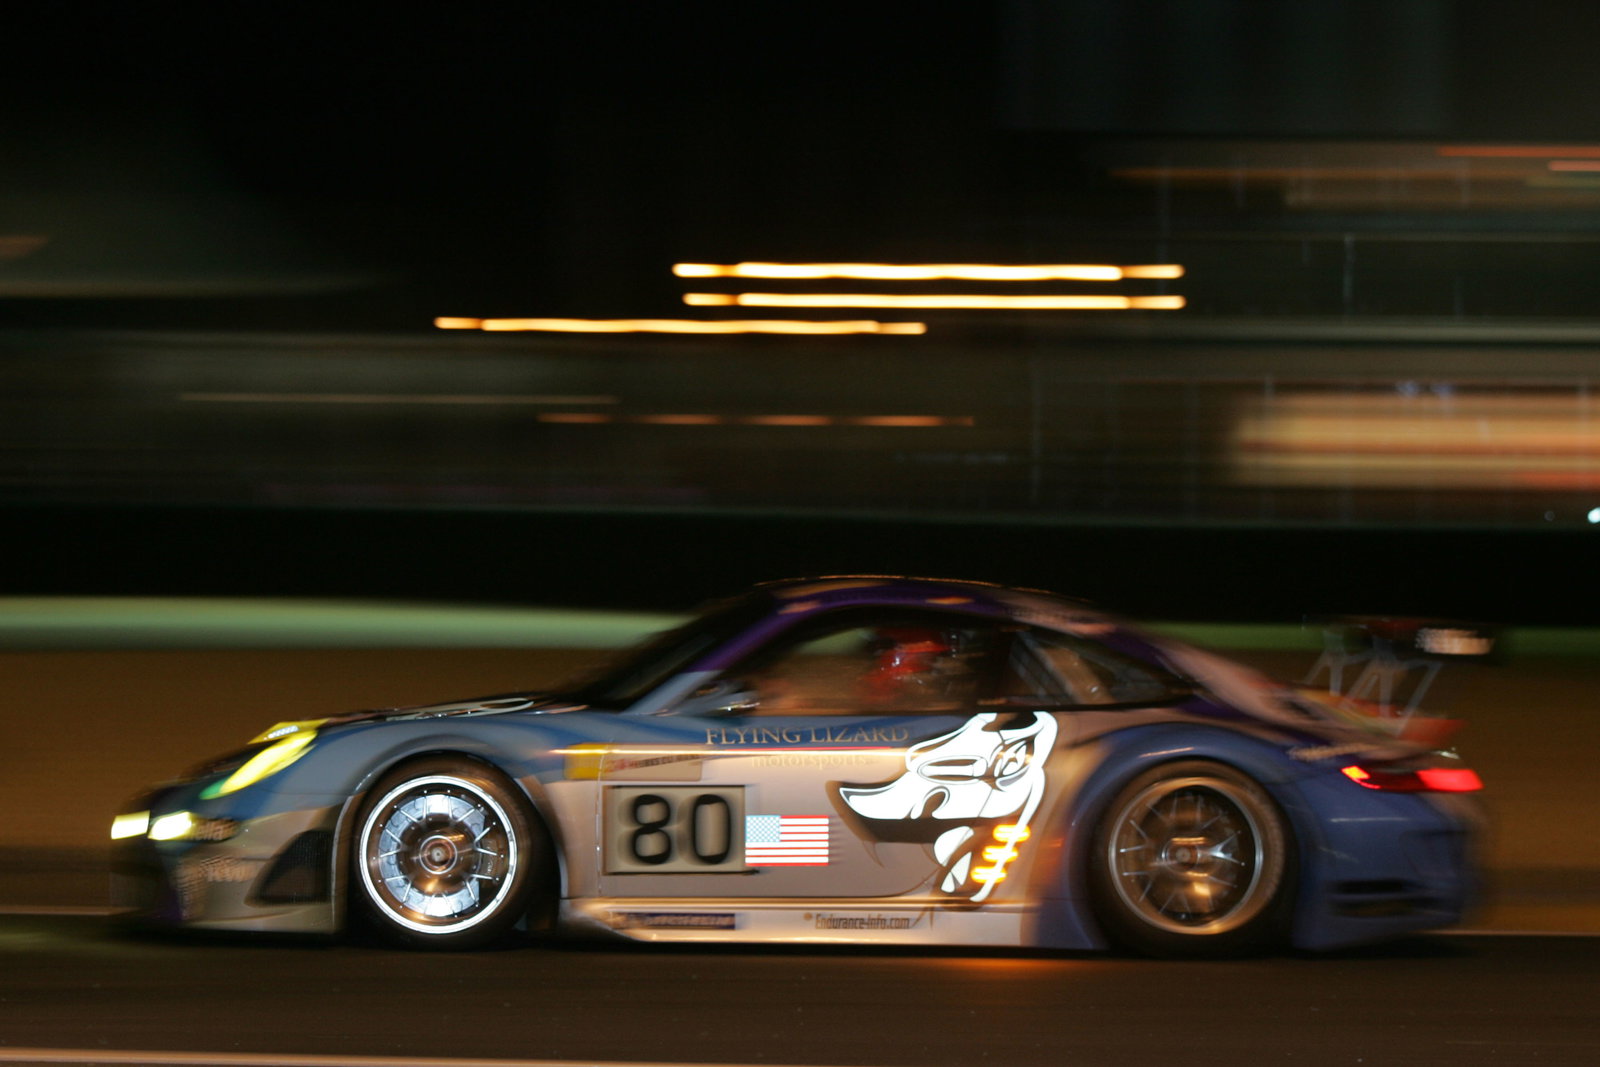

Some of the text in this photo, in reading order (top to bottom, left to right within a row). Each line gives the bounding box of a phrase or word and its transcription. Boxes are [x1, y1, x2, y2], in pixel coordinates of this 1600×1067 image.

[705, 726, 909, 745] FLYING LIZARD
[631, 793, 732, 865] 80
